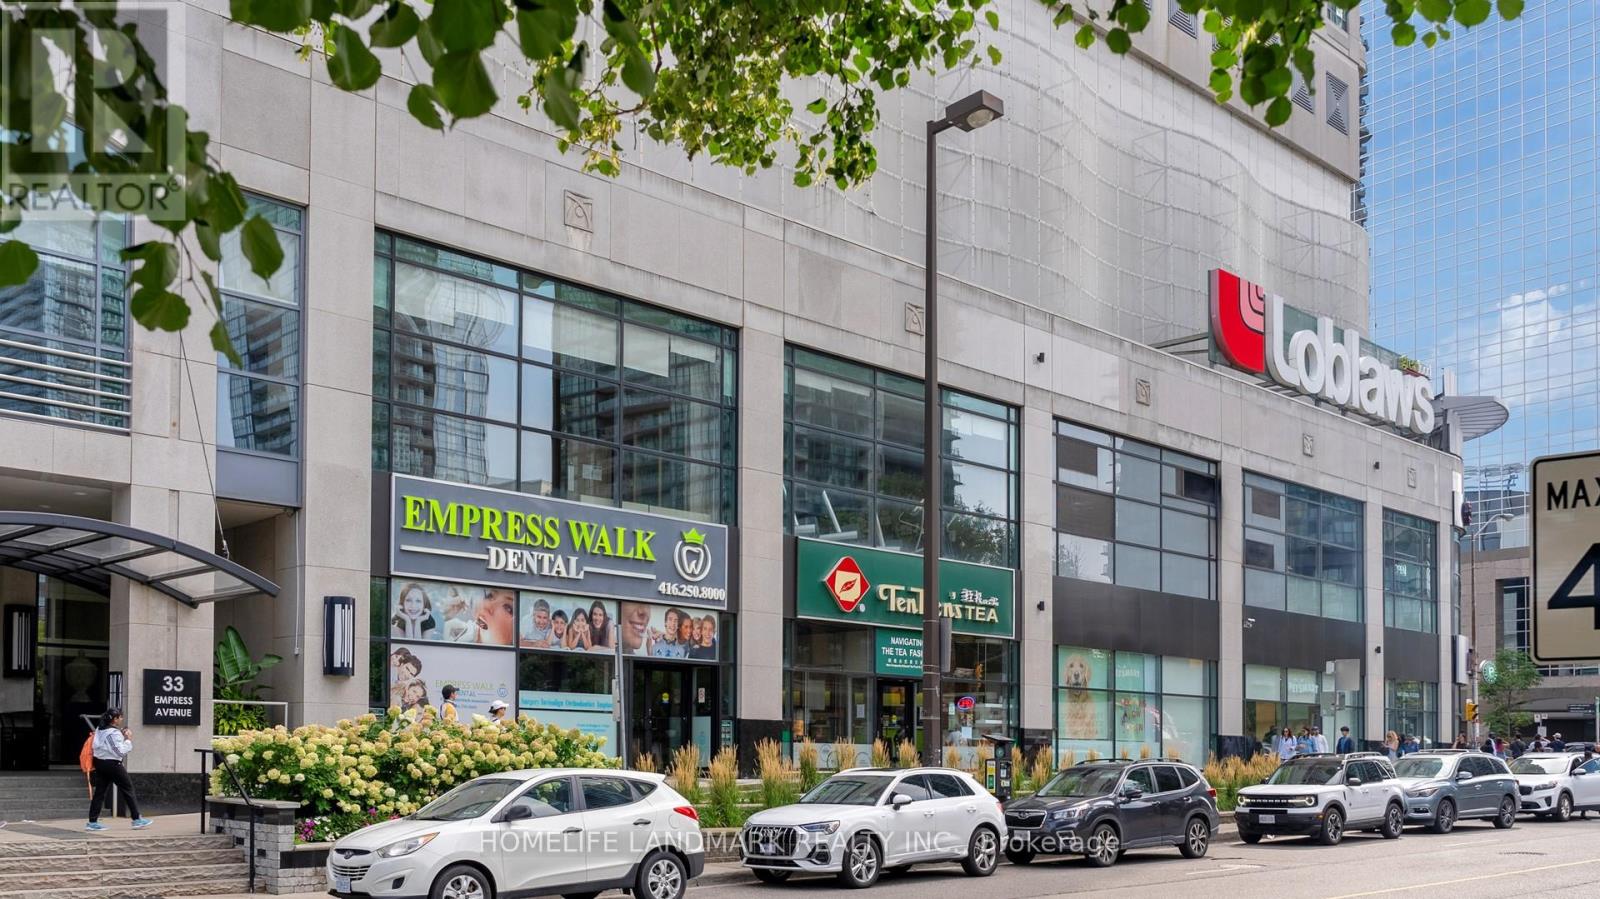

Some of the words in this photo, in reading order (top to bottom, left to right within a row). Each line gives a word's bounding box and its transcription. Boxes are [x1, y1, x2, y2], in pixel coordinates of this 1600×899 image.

[1264, 294, 1435, 434] Loblaws
[402, 495, 560, 549] EMPRESS
[567, 519, 657, 562] WALK
[487, 546, 584, 580] DENTAL
[658, 581, 726, 601] 416.250.8000
[965, 605, 999, 623] TEA
[890, 636, 923, 647] NAVIGATIN
[881, 646, 894, 656] THE
[895, 647, 908, 657] TEA
[162, 675, 184, 692] 33
[155, 696, 193, 705] EMPRESS
[155, 708, 192, 717] AVENUE
